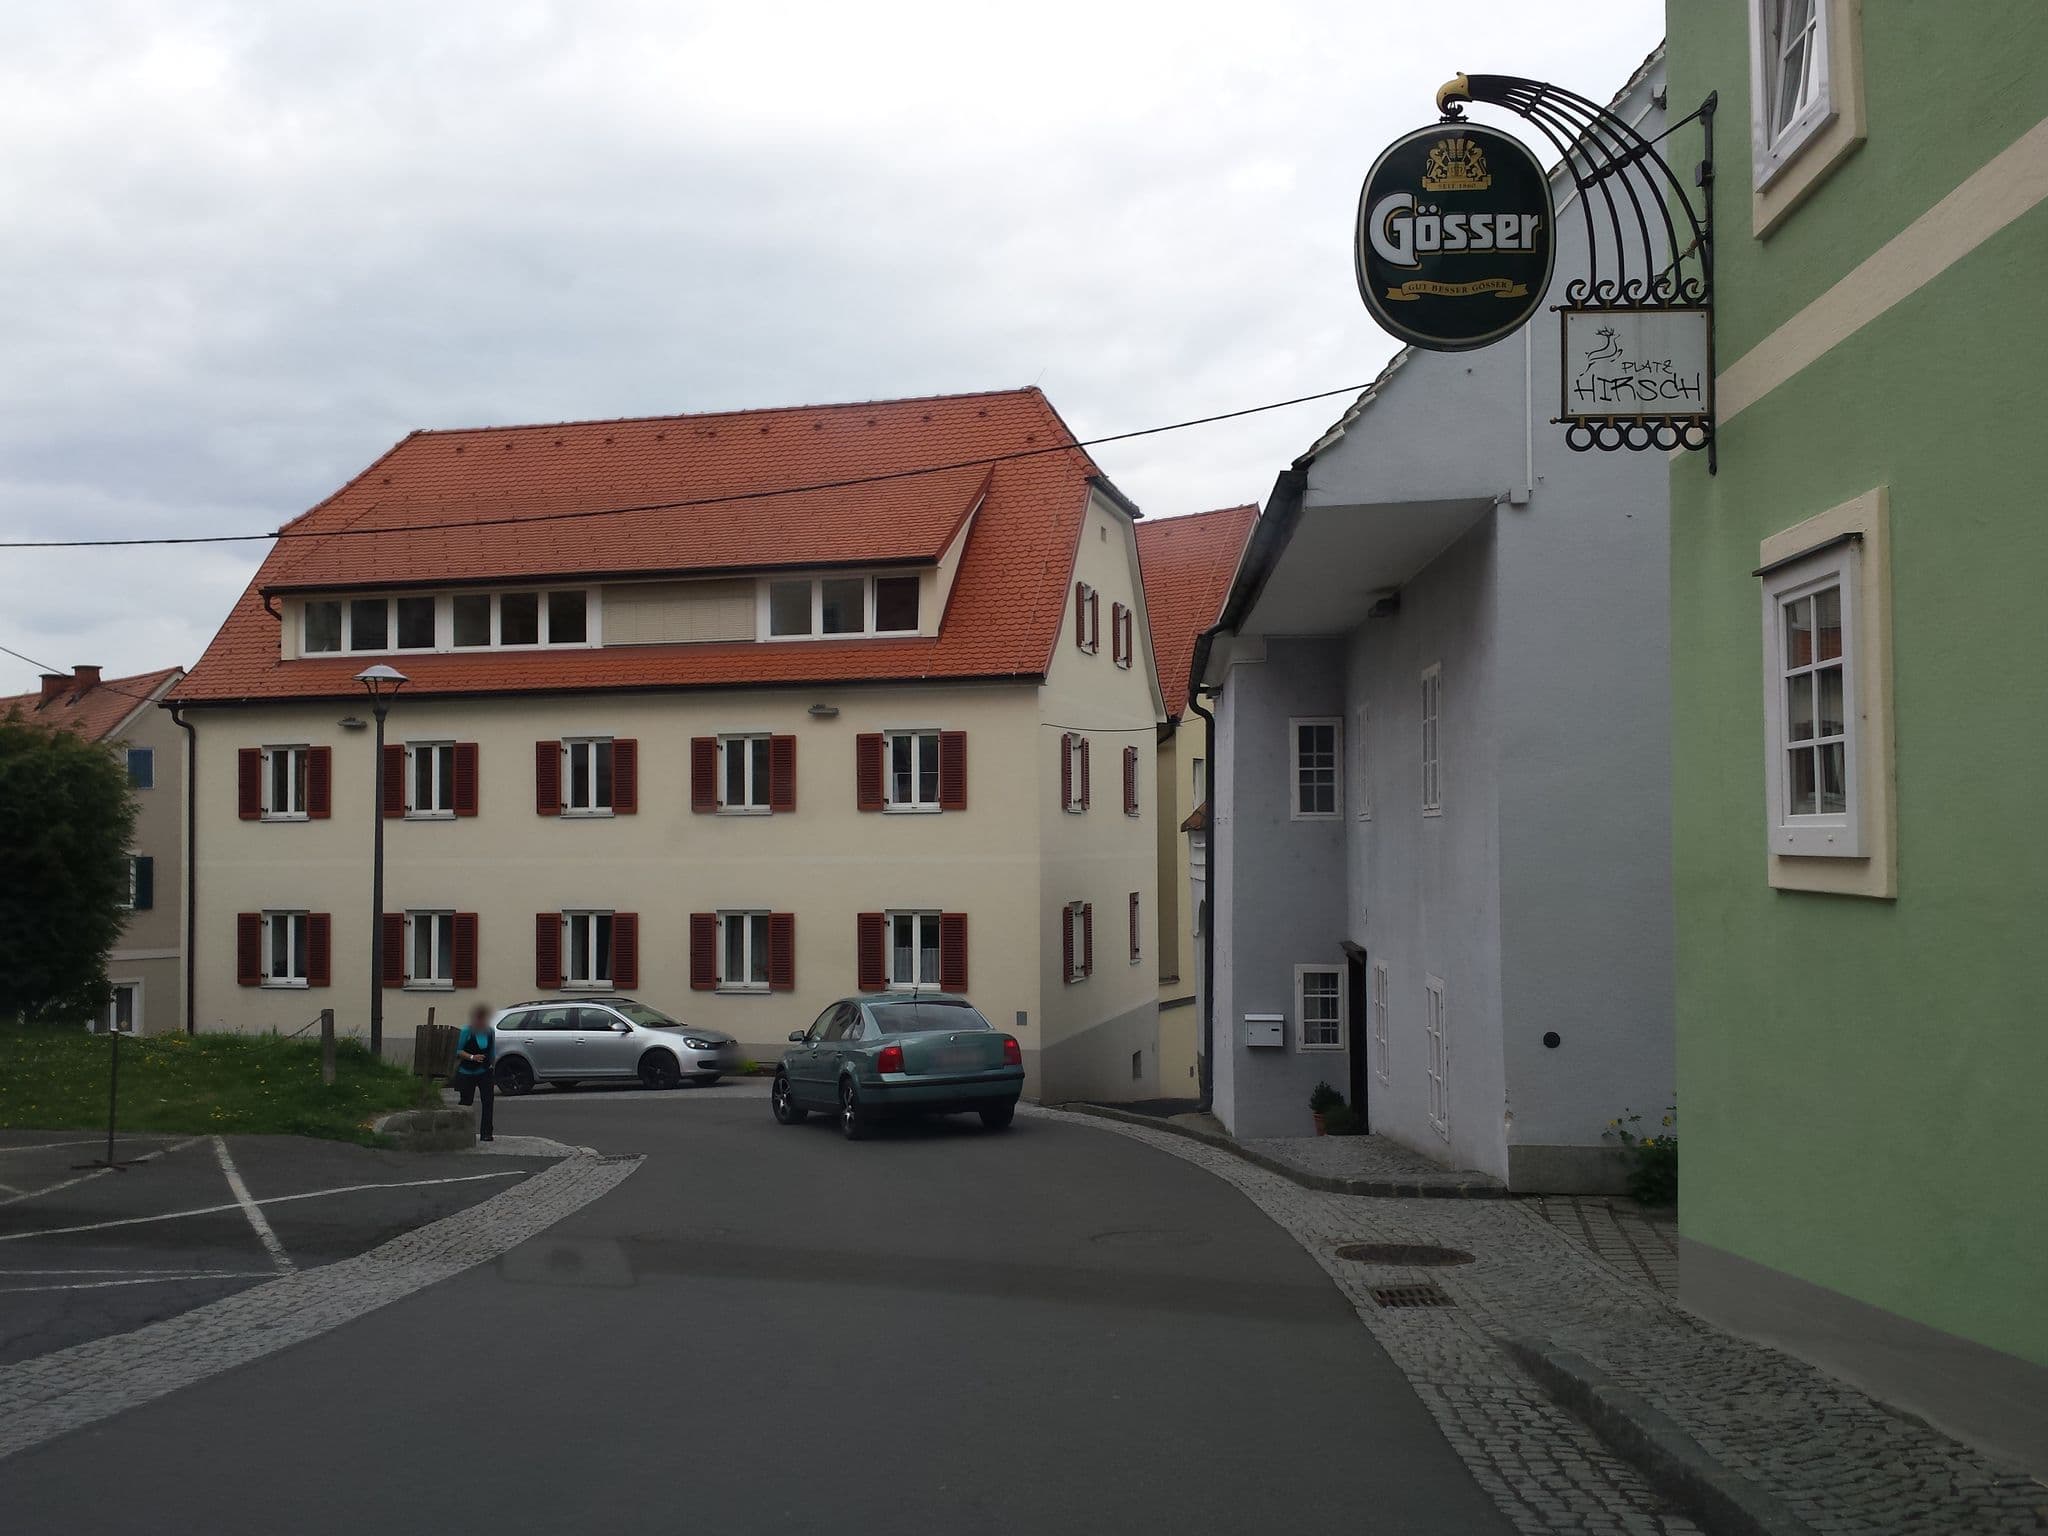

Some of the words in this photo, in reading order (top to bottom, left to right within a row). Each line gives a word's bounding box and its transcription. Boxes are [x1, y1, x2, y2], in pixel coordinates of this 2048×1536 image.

[1369, 193, 1540, 267] Gösser
[1408, 283, 1427, 292] GUT
[1431, 284, 1468, 294] BESSER
[1621, 359, 1673, 375] PLATZ
[1573, 372, 1701, 402] HIRSCH
